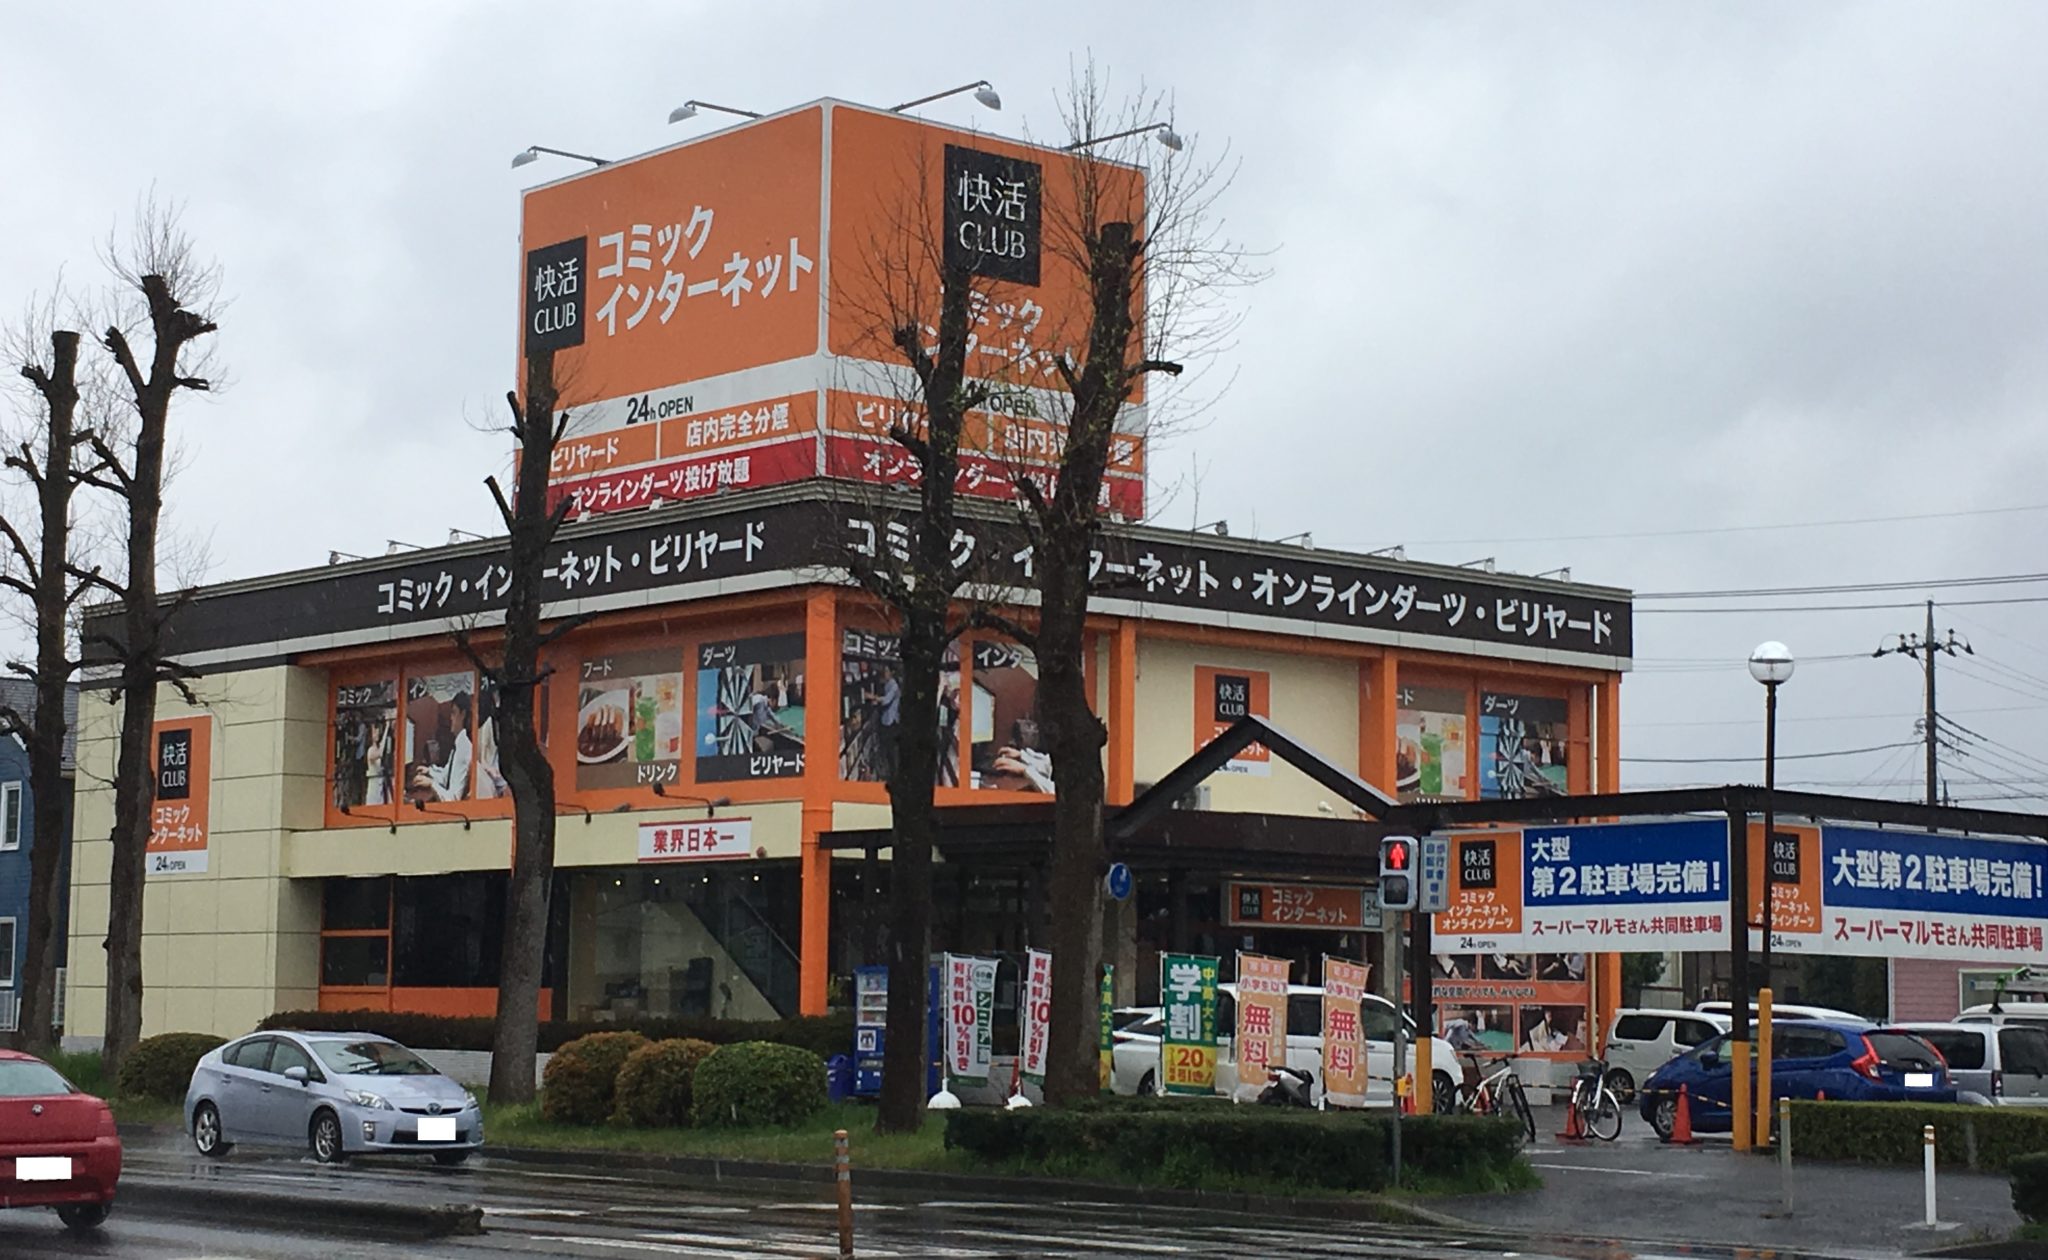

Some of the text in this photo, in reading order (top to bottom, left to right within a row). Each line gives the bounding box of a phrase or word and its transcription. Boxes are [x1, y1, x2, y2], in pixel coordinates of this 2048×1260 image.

[961, 171, 1027, 222] 快活
[598, 205, 714, 278] コミック
[959, 221, 1026, 259] CLUB
[534, 257, 579, 303] 快活
[596, 237, 814, 337] インターネット
[534, 302, 577, 334] CLUB
[940, 284, 1043, 335] ミック
[657, 396, 694, 419] OPEN
[686, 402, 790, 448] 店内完全分煙
[550, 437, 619, 473] ビリヤード
[571, 455, 751, 512] オンラインダーツ投げ放題
[377, 521, 765, 615] コミック・インーネット・ビリヤード
[703, 646, 736, 666] ダーツ
[583, 659, 613, 678] フード
[338, 687, 372, 706] コミック
[1219, 684, 1245, 702] 快活
[1219, 702, 1245, 716] CLUB
[1484, 695, 1519, 714] ダーツ
[162, 742, 187, 766] 快活
[750, 754, 805, 776] ビリヤード
[162, 770, 187, 788] CLUB
[637, 763, 677, 784] ドリンク
[155, 805, 190, 824] コミック
[653, 827, 735, 854] 業界日本一
[1531, 836, 1571, 863] 大型
[1773, 841, 1796, 860] 快活
[1464, 849, 1491, 866] 快活
[1773, 862, 1796, 875] CLUB
[1464, 868, 1491, 881] CLUB
[1531, 860, 1722, 898] 第2駐車場完備!
[1832, 849, 2043, 899] 大型第2駐車場完備!
[1272, 889, 1314, 905] コミック
[1460, 891, 1495, 904] コミック
[1272, 906, 1347, 924] インターネット
[1447, 904, 1509, 918] インターネット
[1442, 917, 1514, 931] オンラインダーツ
[1531, 915, 1724, 936] スーパーマルモさん共同駐車場
[1834, 917, 2044, 952] スーパーマルモさん共同駐車場
[1477, 941, 1497, 949] OPEN
[1241, 977, 1288, 993] 小学生以下
[1169, 963, 1202, 1041] 学割
[1244, 1003, 1272, 1071] 無料
[1328, 1009, 1357, 1079] 無料
